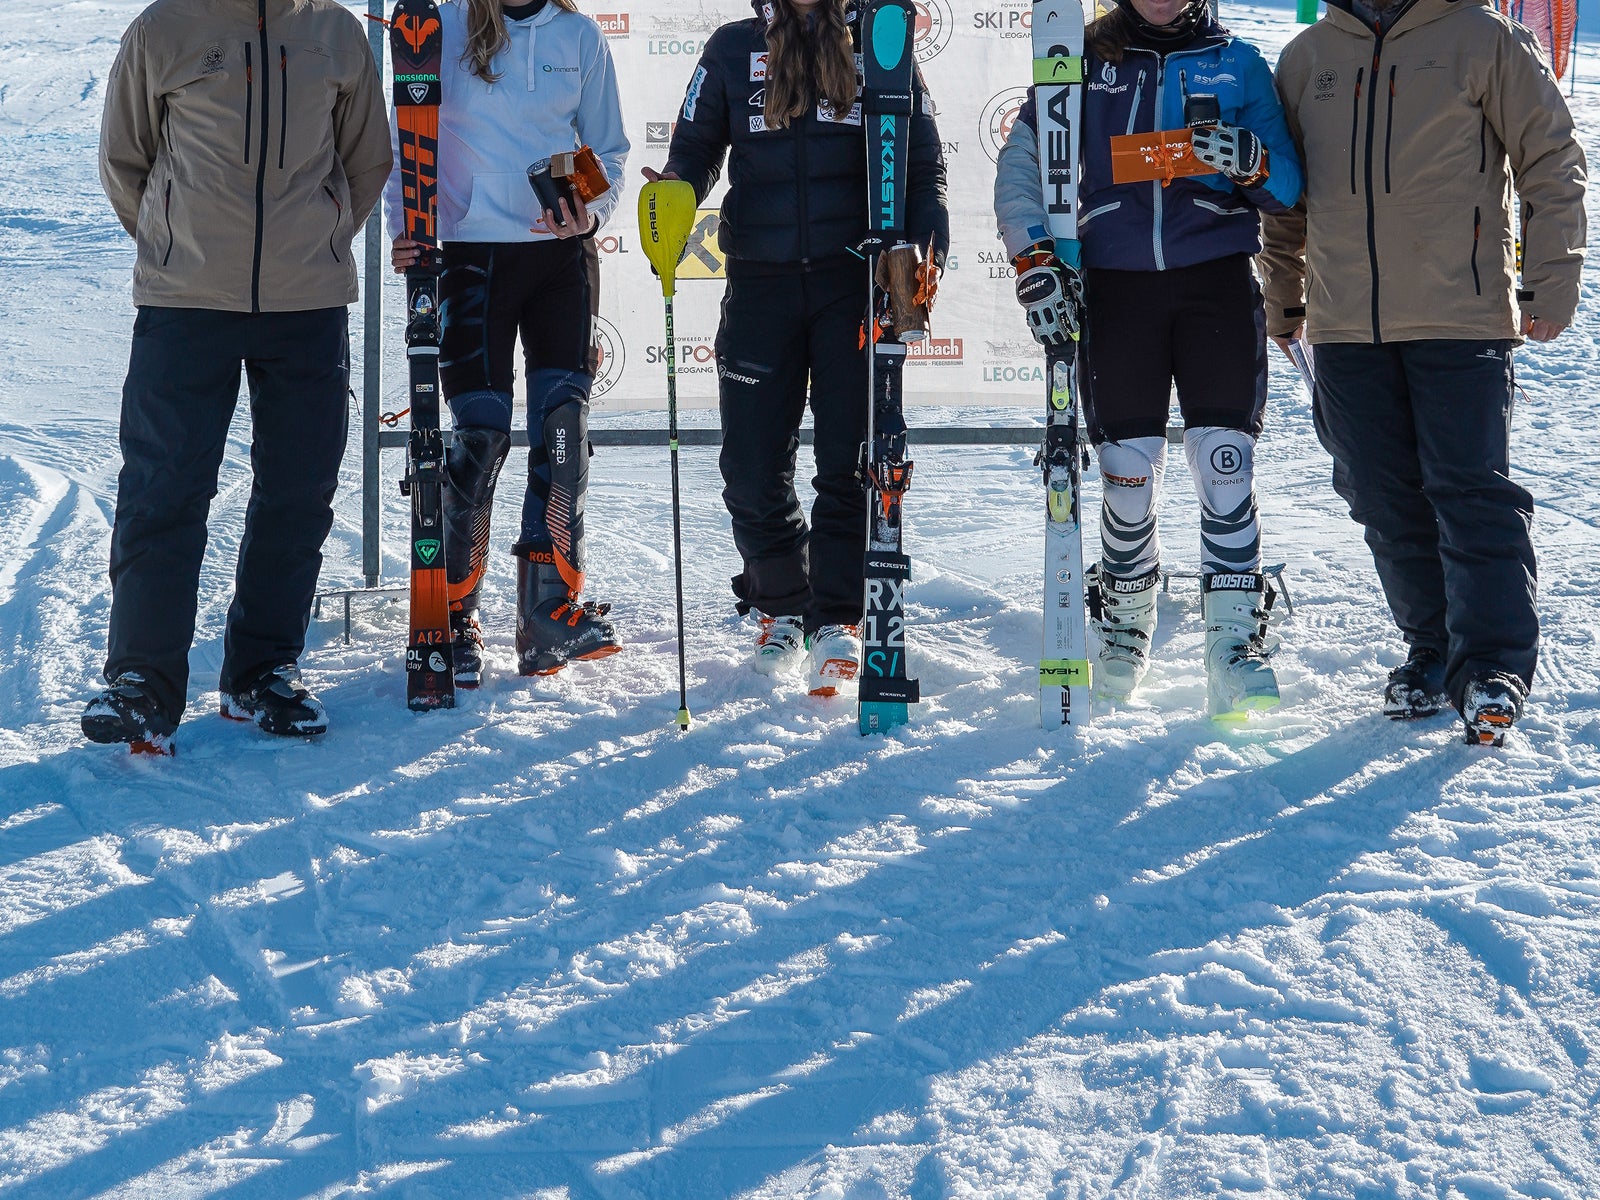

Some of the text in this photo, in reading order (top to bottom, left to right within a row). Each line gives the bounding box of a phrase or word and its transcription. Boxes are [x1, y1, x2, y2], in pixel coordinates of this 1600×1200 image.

[973, 11, 1003, 29] SKI
[648, 40, 706, 55] LEOGA
[394, 73, 440, 82] ROSSIGNOL
[687, 68, 704, 108] DAIKIN
[1047, 45, 1071, 214] HEA
[649, 192, 659, 243] GABEL
[1018, 278, 1048, 297] ziener
[645, 345, 669, 364] SK
[905, 338, 960, 356] aalbach
[725, 368, 760, 385] ziener
[982, 366, 1044, 382] LEOGA
[556, 428, 566, 464] SHRED
[1211, 478, 1245, 486] BOGNER
[1211, 574, 1256, 589] BOOSTER
[867, 579, 905, 611] RX
[866, 615, 905, 647] 12
